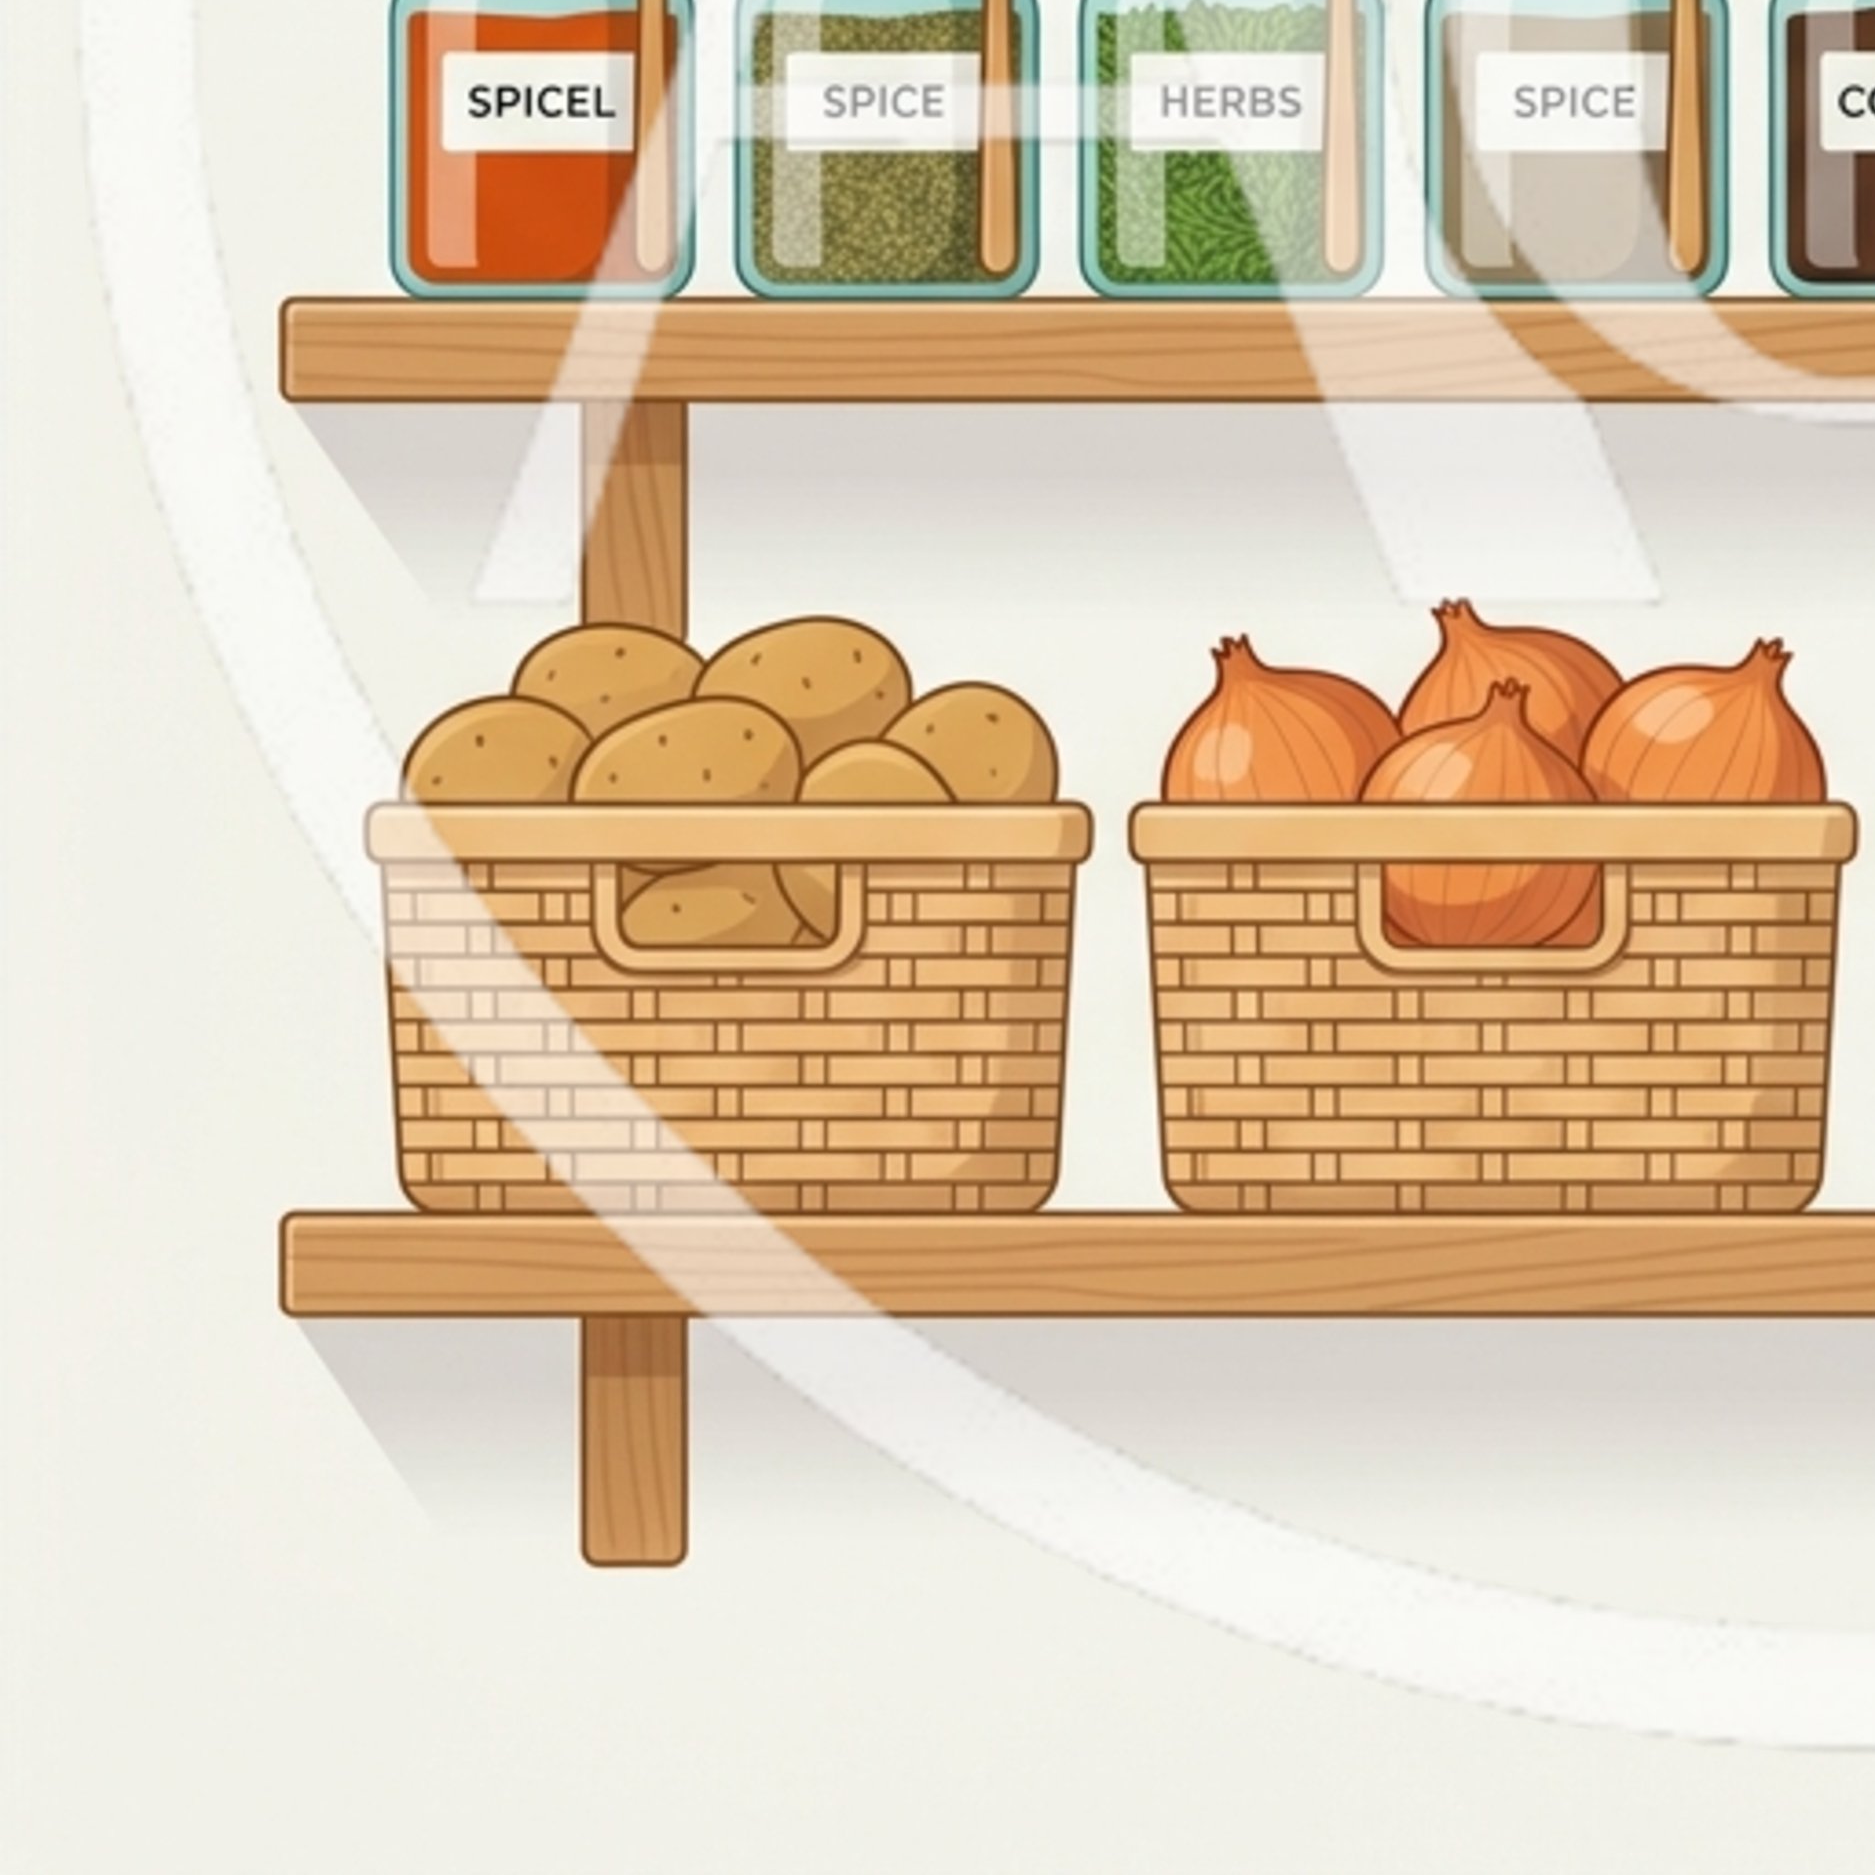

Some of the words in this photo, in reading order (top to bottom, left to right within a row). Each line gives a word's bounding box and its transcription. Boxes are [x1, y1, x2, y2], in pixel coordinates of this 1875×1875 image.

[467, 83, 618, 119] SPICEL
[822, 84, 944, 118] SPICE
[1160, 85, 1303, 118] HERBS
[1513, 84, 1637, 118] SPICE
